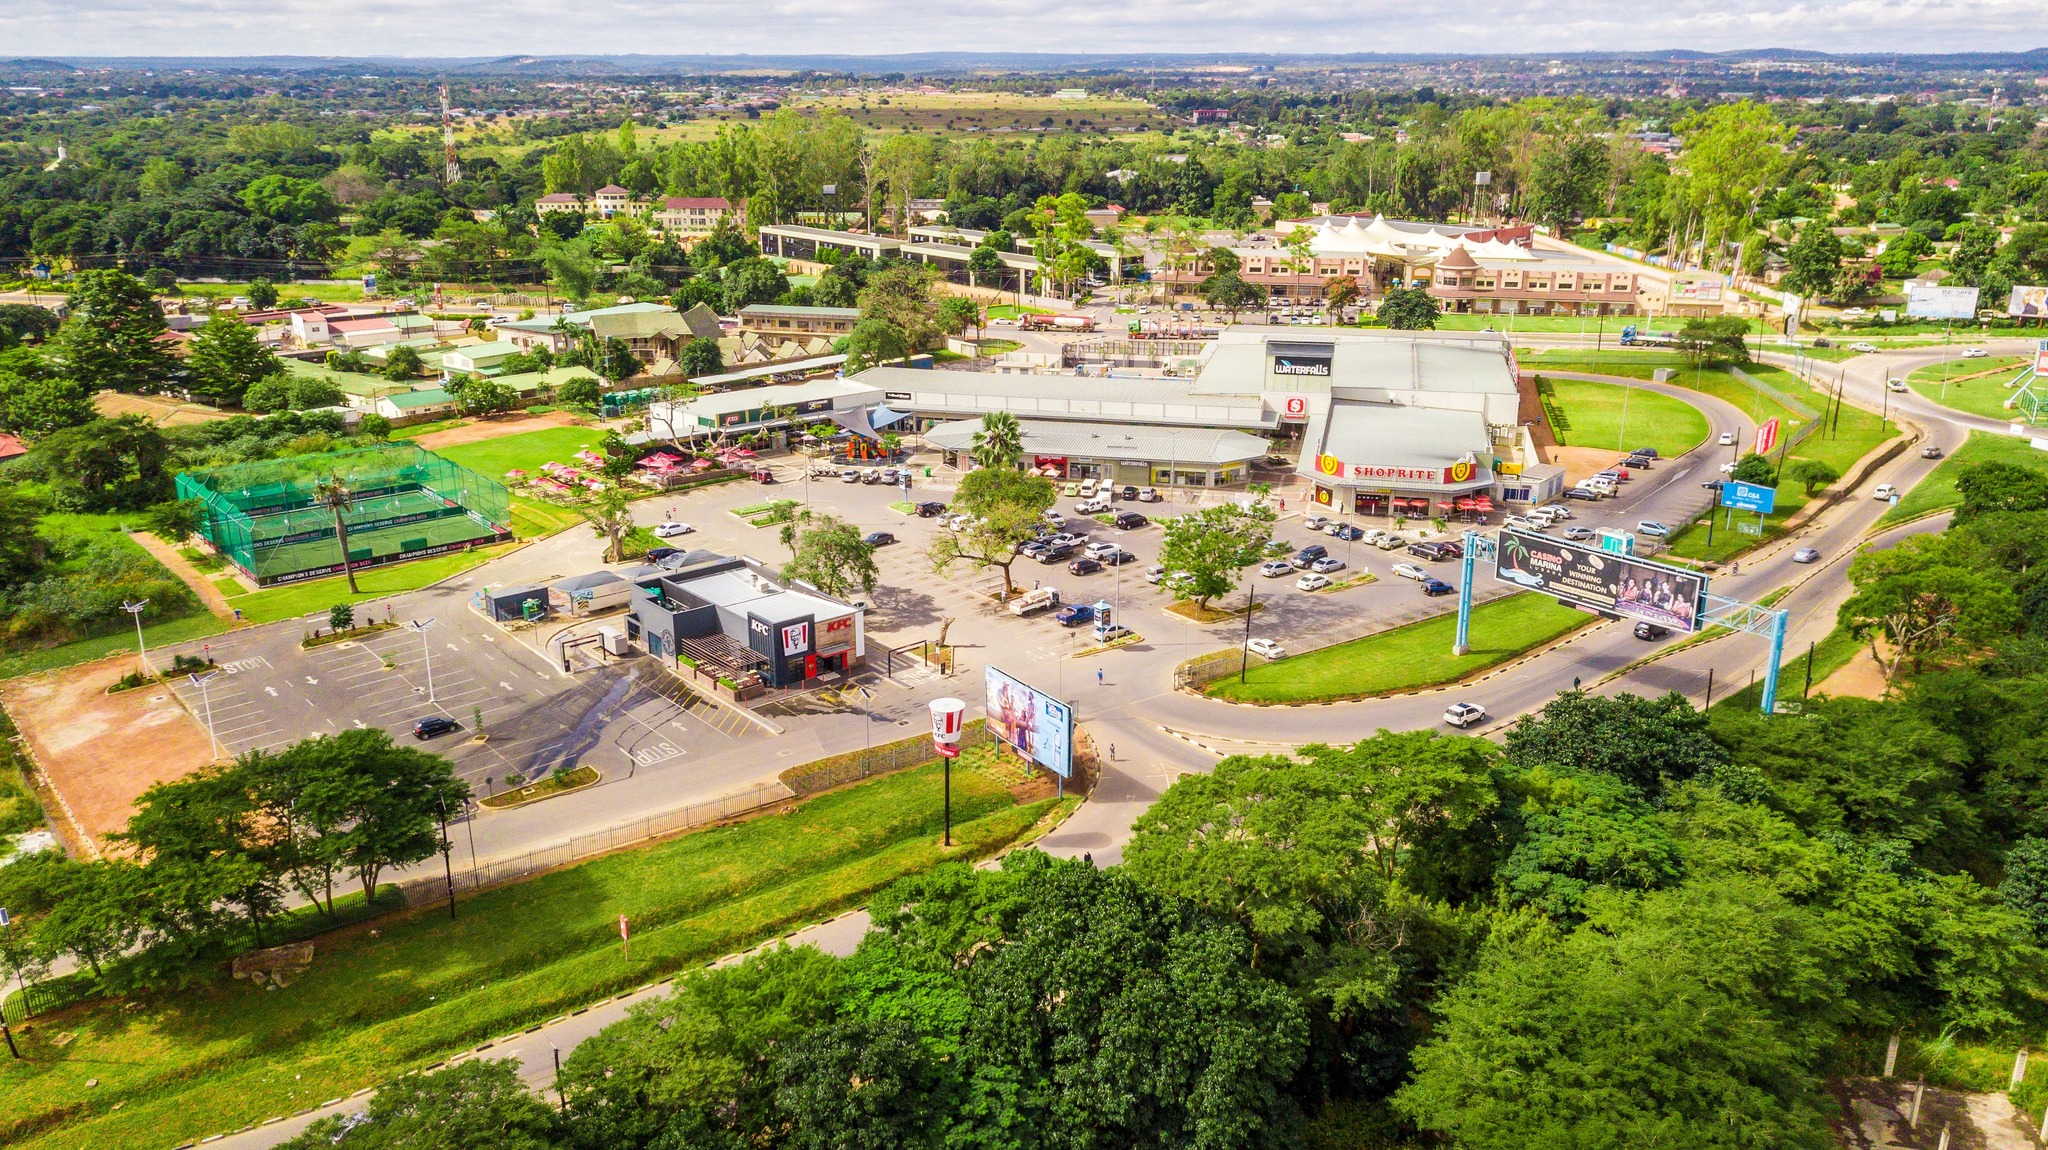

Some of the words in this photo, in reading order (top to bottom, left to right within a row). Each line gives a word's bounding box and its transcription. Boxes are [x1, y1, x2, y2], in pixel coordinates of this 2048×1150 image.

[1353, 466, 1436, 480] SHOPRITE
[1530, 550, 1563, 564] CASINO
[1530, 557, 1562, 572] MARINA
[1576, 563, 1597, 575] YOUR
[1568, 570, 1602, 584] WINNING
[1562, 577, 1608, 594] DESTINATION
[751, 619, 769, 636] KFC
[827, 617, 852, 633] KFC
[222, 657, 262, 674] STOP
[636, 742, 679, 764] STOP
